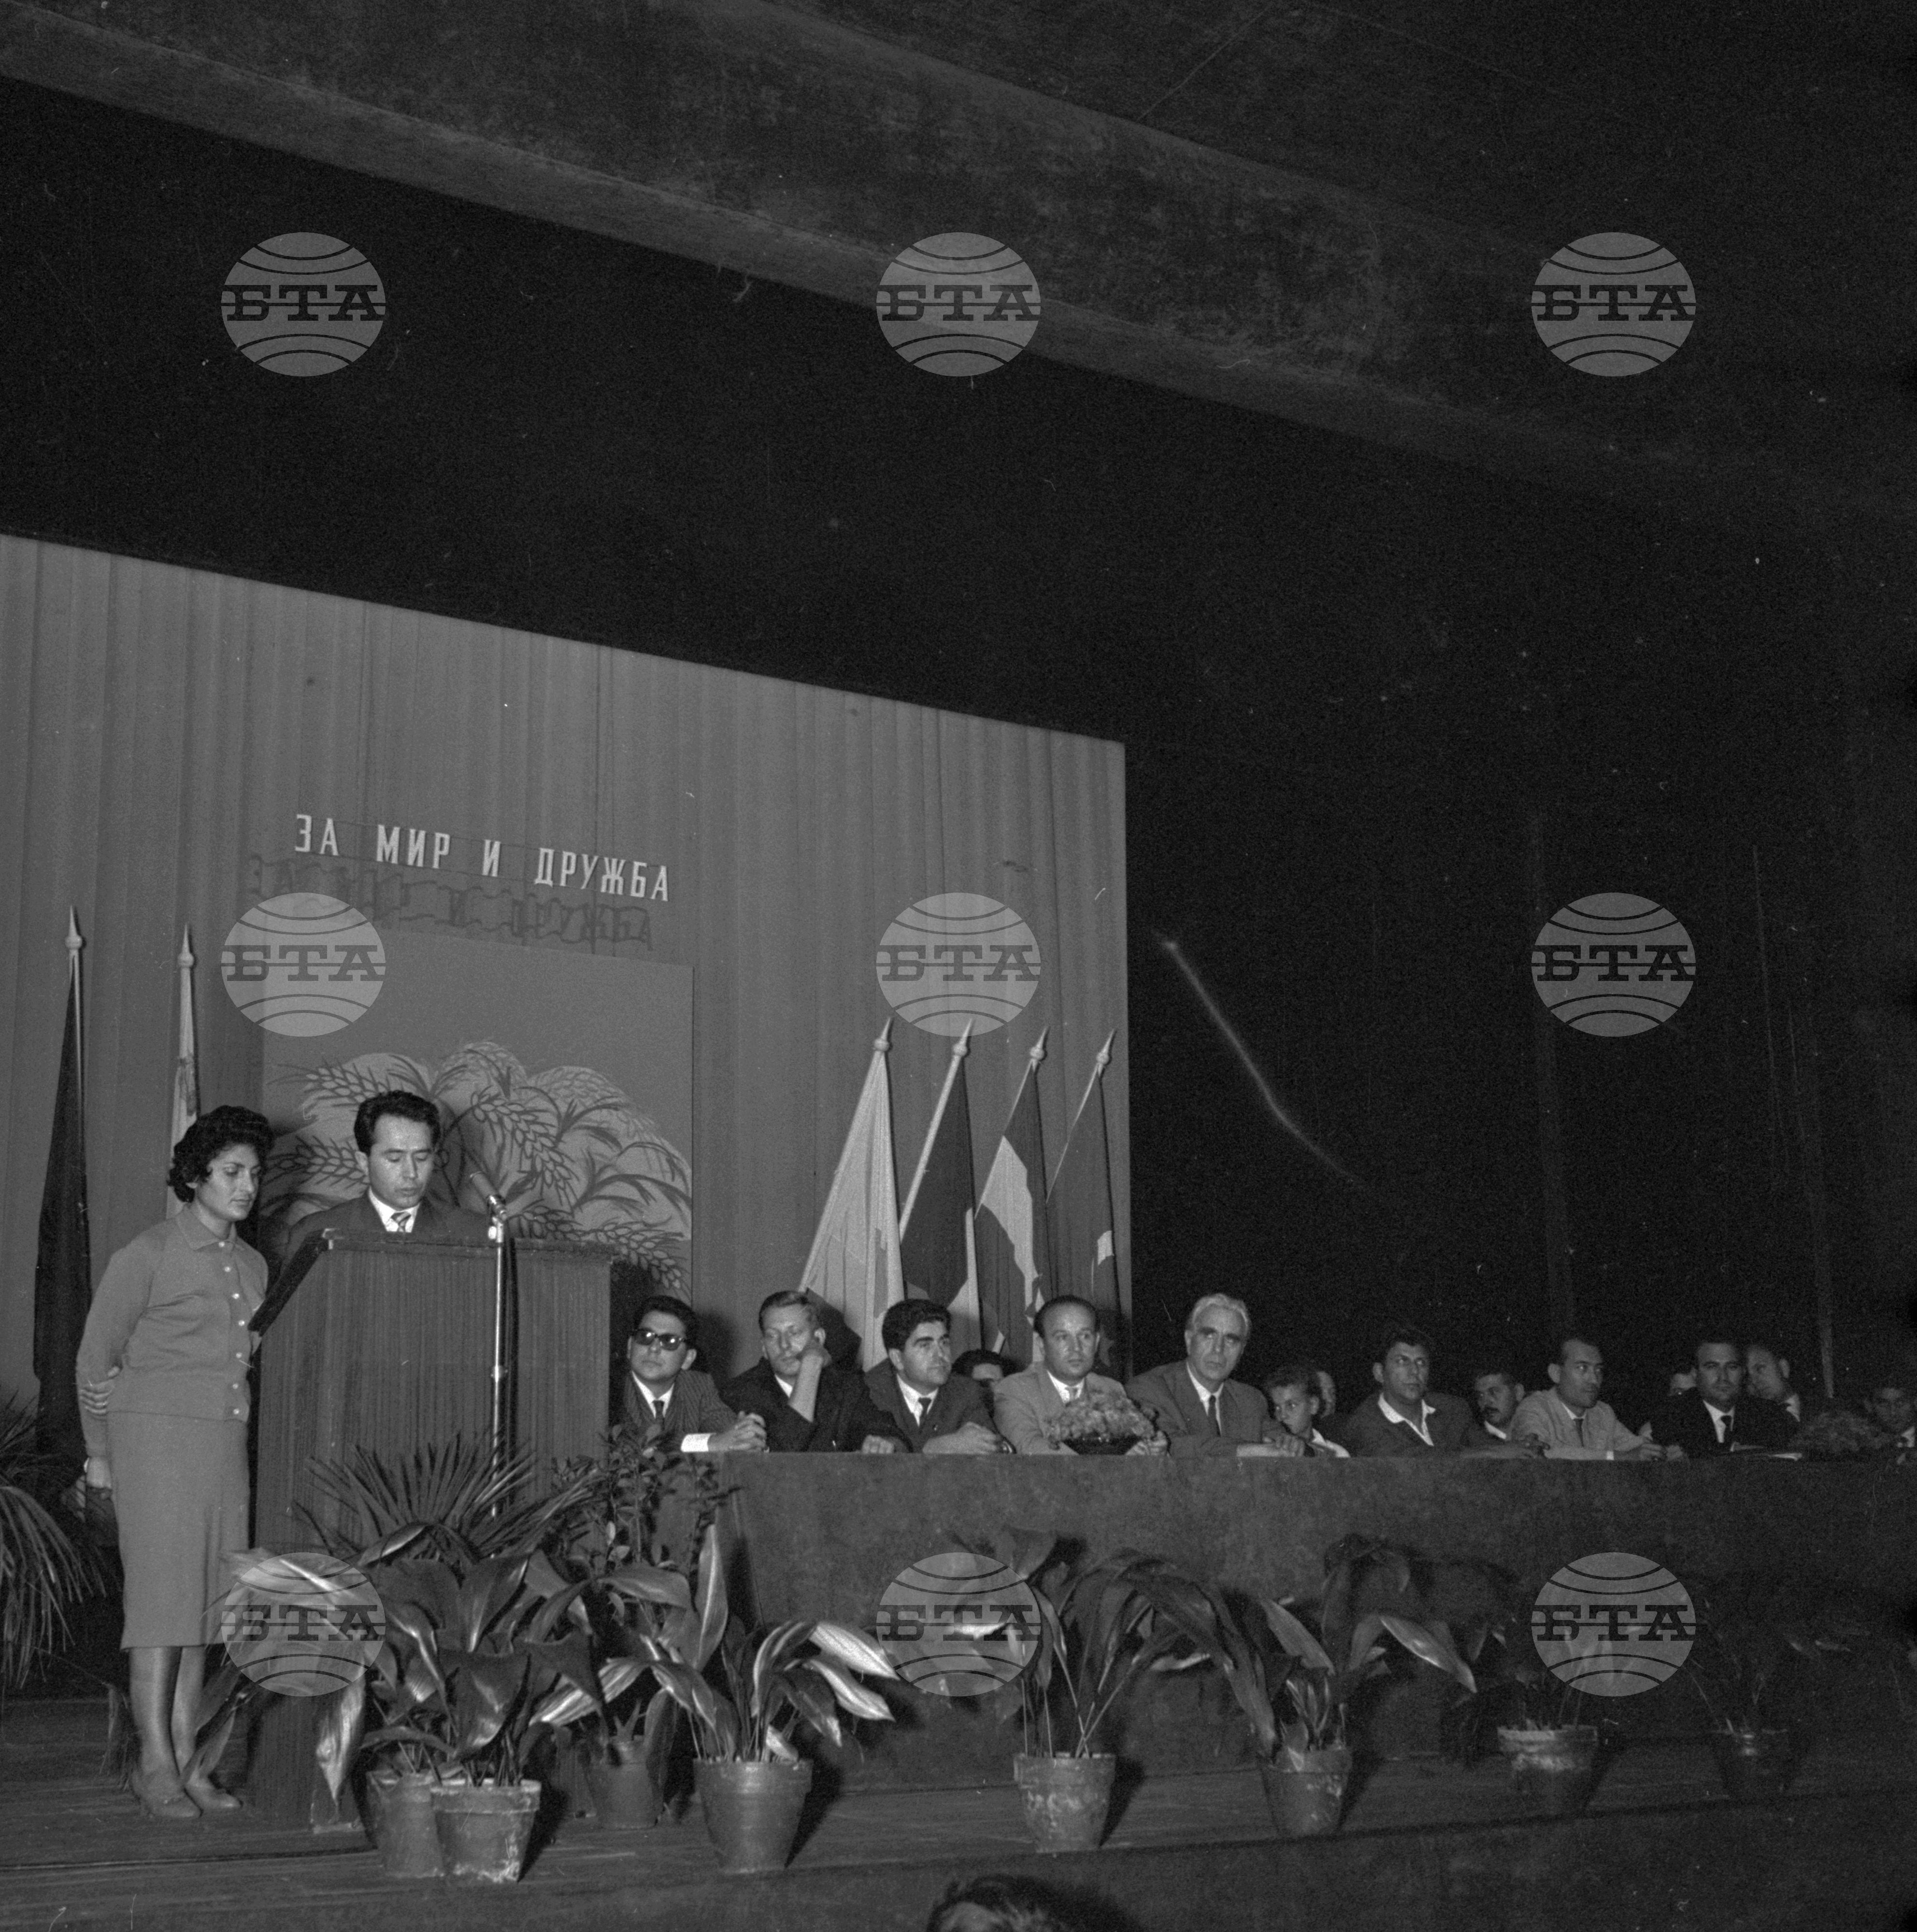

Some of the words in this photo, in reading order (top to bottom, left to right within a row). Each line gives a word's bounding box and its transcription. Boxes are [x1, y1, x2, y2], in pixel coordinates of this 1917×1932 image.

[295, 814, 339, 856] ЗА
[376, 824, 451, 868] МИР
[483, 839, 501, 877] И
[534, 847, 669, 902] ДРУЖБА
